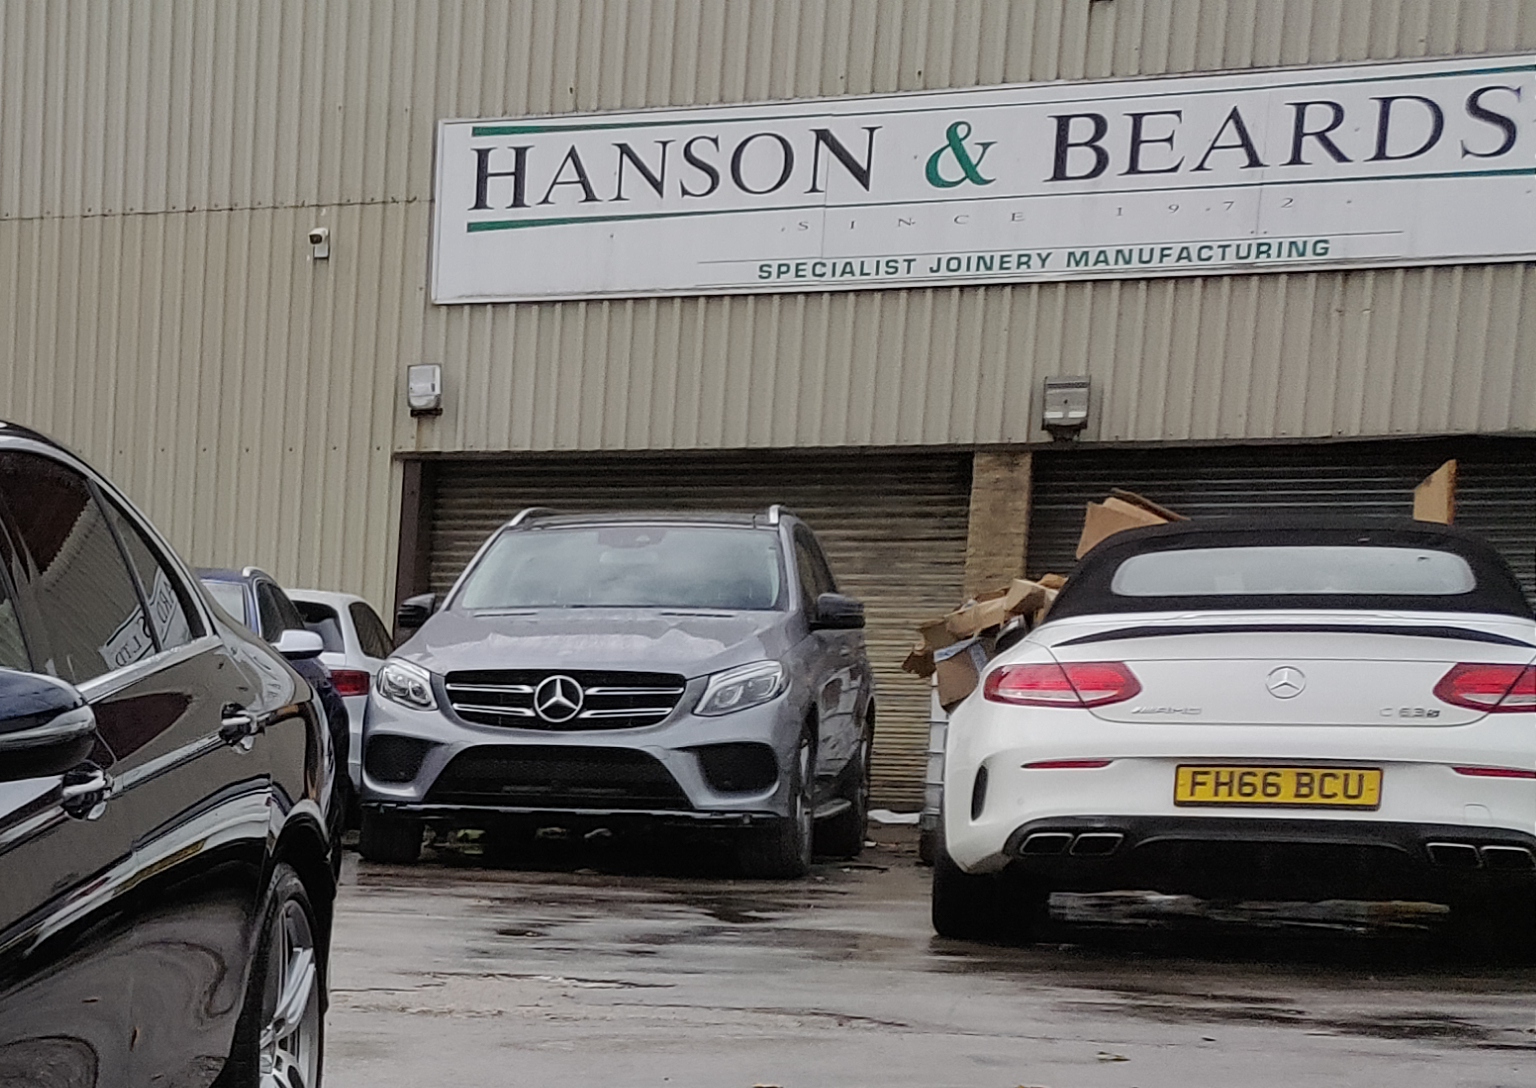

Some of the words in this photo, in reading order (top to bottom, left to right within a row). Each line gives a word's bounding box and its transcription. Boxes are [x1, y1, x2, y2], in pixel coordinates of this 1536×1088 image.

[467, 126, 883, 211] HANSON
[924, 120, 996, 189] &
[1043, 85, 1522, 183] BEARDS
[797, 211, 1025, 231] SINCE
[1115, 197, 1294, 216] 1972
[758, 258, 917, 279] SPECIALIST
[929, 252, 1052, 273] JOINERY
[1066, 239, 1330, 267] MANUFACTURING
[1189, 770, 1282, 798] FH66
[1293, 772, 1364, 800] BCU
